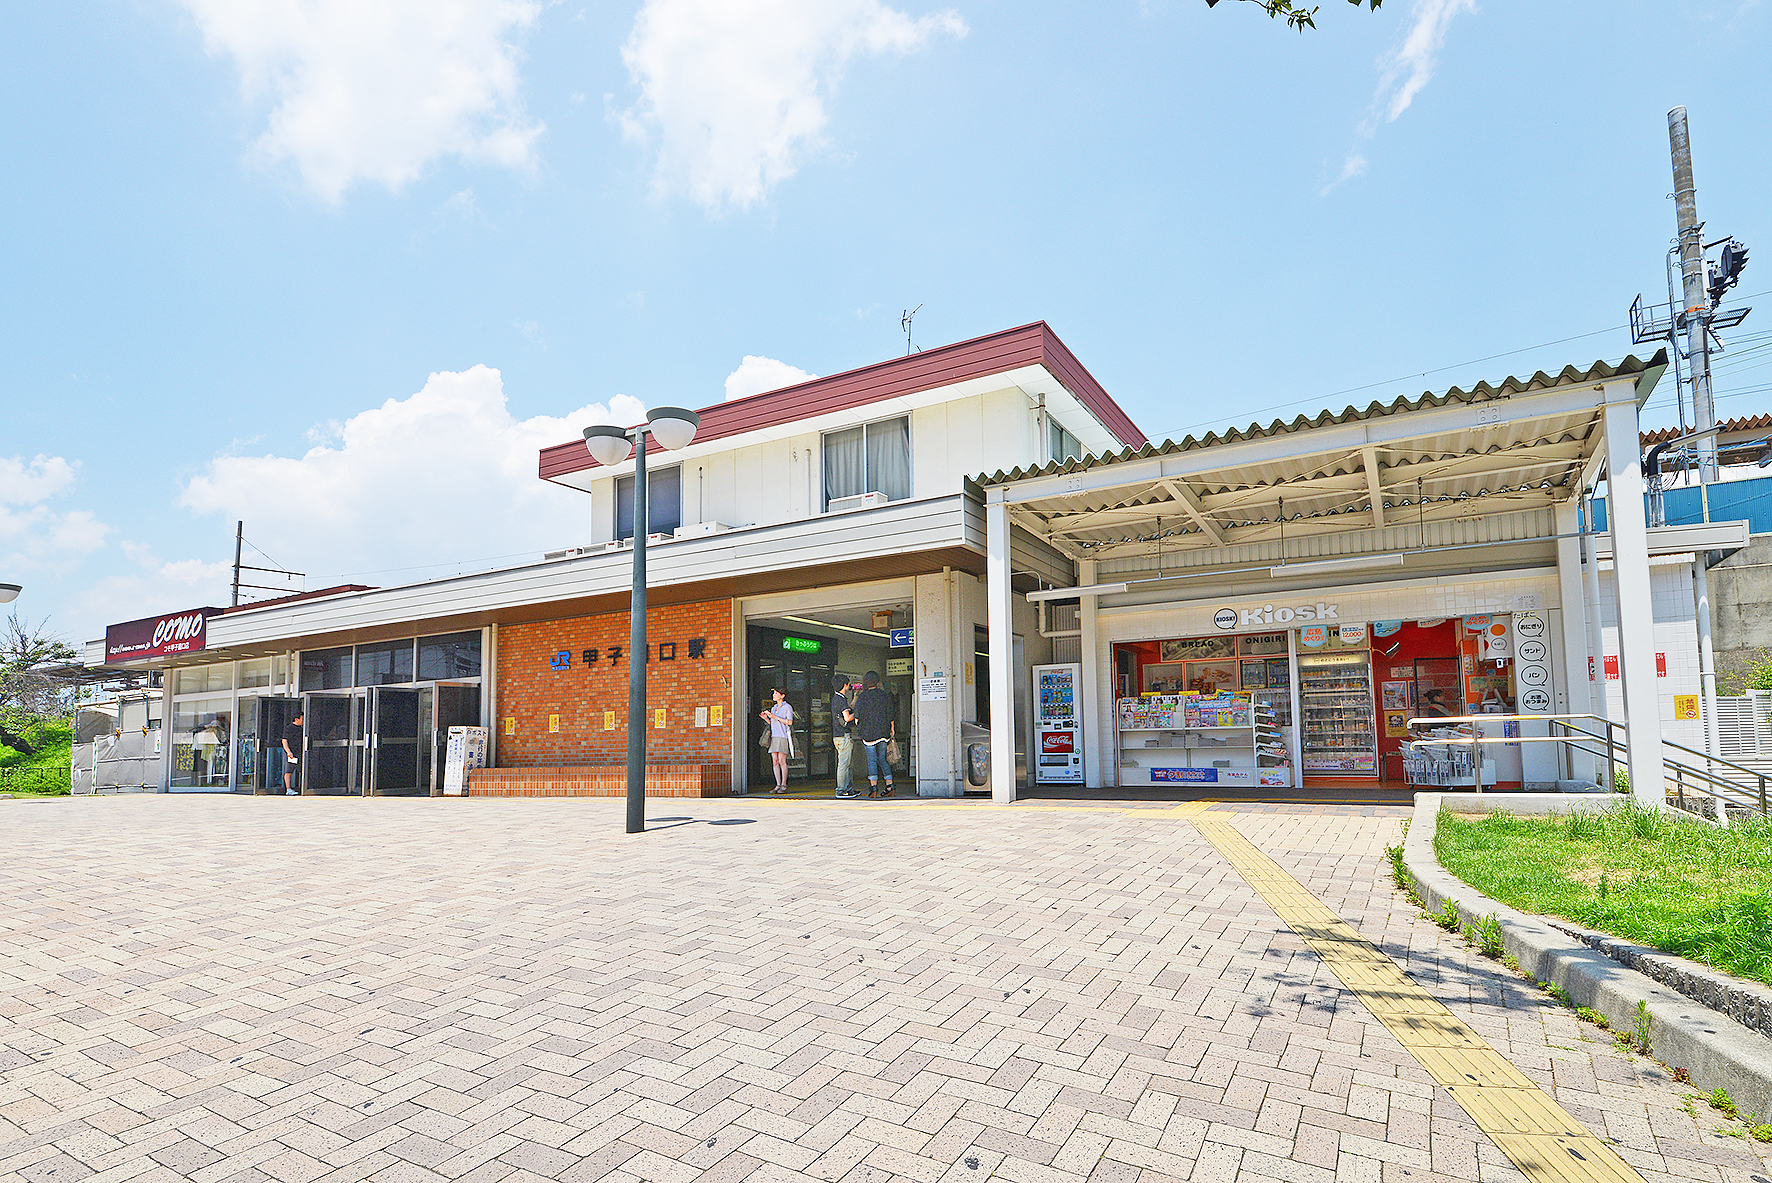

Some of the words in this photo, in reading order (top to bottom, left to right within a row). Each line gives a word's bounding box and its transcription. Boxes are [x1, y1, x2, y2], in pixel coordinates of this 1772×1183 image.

[1240, 603, 1339, 626] Kiosk
[152, 612, 203, 648] COMO
[1245, 635, 1286, 645] ONIGIRI
[549, 651, 570, 666] JR
[582, 638, 706, 668] 甲子口駅
[1181, 640, 1214, 648] BREAD
